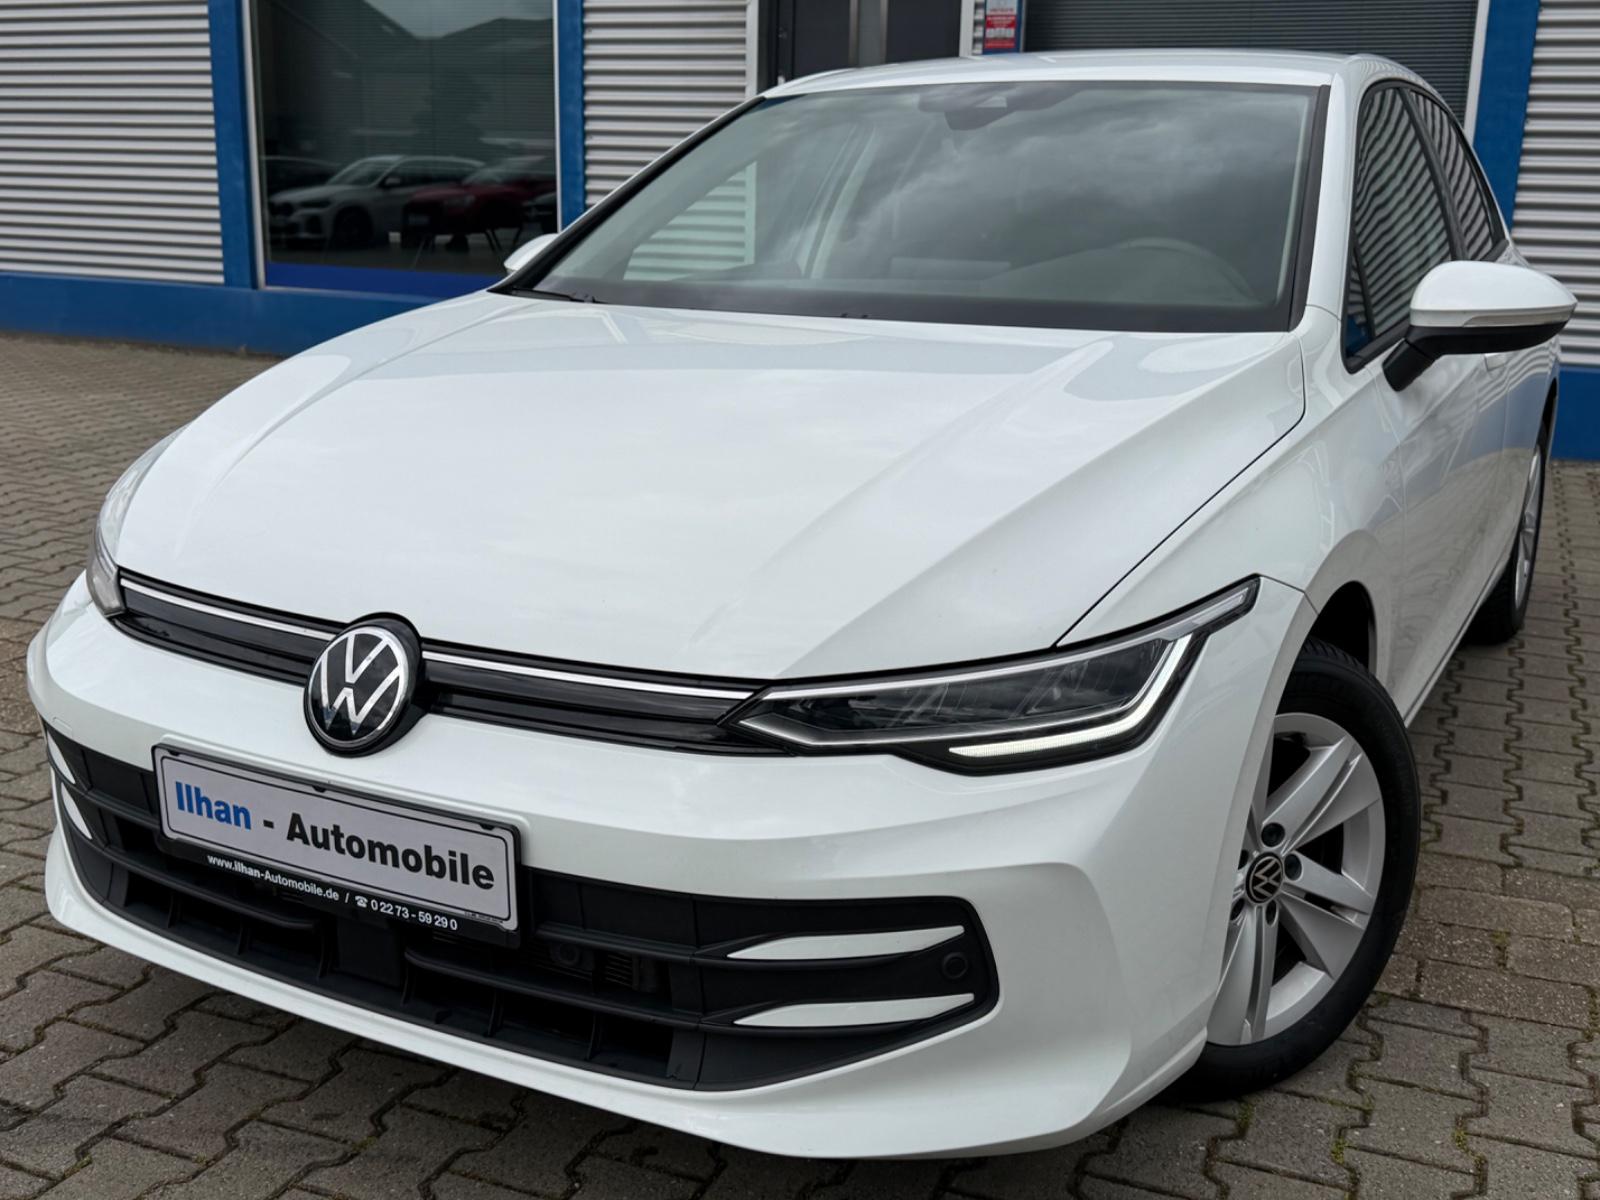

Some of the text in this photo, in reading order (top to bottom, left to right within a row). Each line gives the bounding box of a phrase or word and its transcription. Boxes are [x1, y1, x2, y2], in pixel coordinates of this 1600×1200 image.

[175, 782, 495, 890] Ilhan - Automobile
